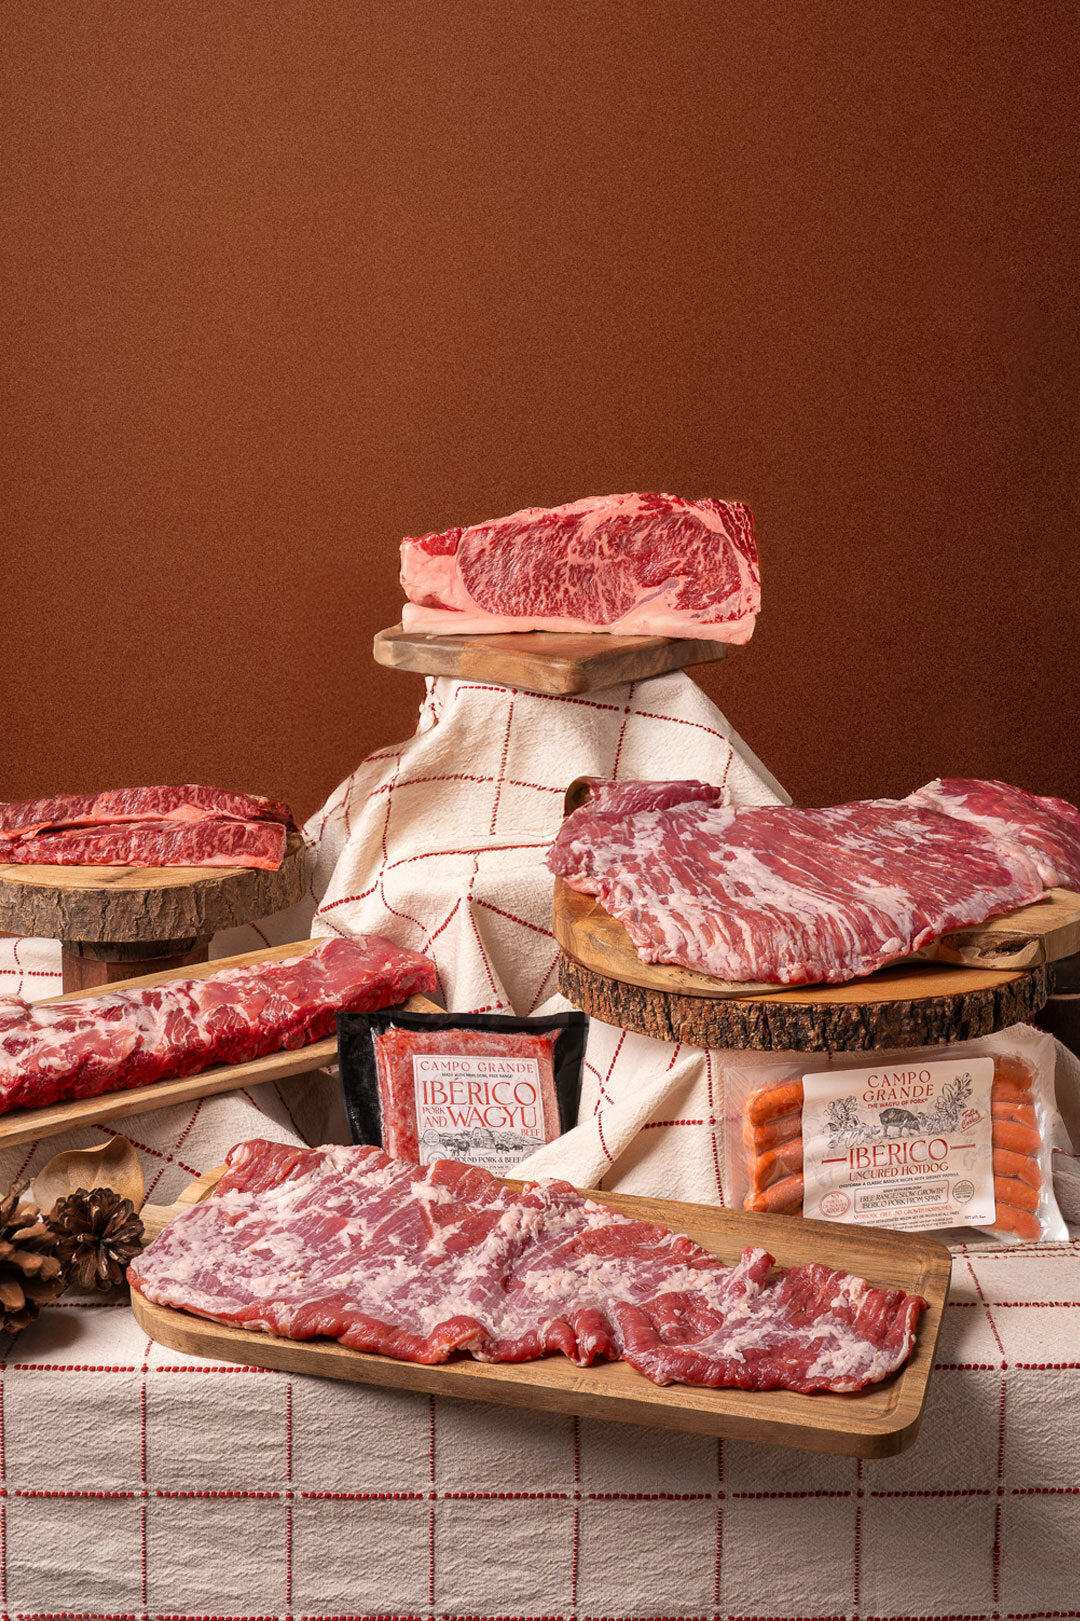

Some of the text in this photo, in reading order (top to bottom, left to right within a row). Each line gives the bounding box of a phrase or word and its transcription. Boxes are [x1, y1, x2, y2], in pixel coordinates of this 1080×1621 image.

[420, 1060, 534, 1074] CAMPO GRANDE
[867, 1069, 931, 1089] CAMPO
[422, 1077, 537, 1106] IBÉRICO
[862, 1083, 934, 1103] GRANDE
[422, 1106, 446, 1114] PORK
[424, 1106, 537, 1128] AND WAGYU
[961, 1108, 981, 1118] Fully
[520, 1128, 541, 1137] BEEF
[478, 1156, 496, 1164] PORK
[504, 1156, 520, 1164] BEEF
[849, 1138, 948, 1170] IBÉRICO
[849, 1161, 949, 1182] UNCURED HOTDOG
[859, 1194, 874, 1203] FREE
[899, 1190, 916, 1199] SLOW
[888, 1198, 906, 1207] PORK
[906, 1196, 924, 1205] FROM
[924, 1194, 941, 1202] SPAIN
